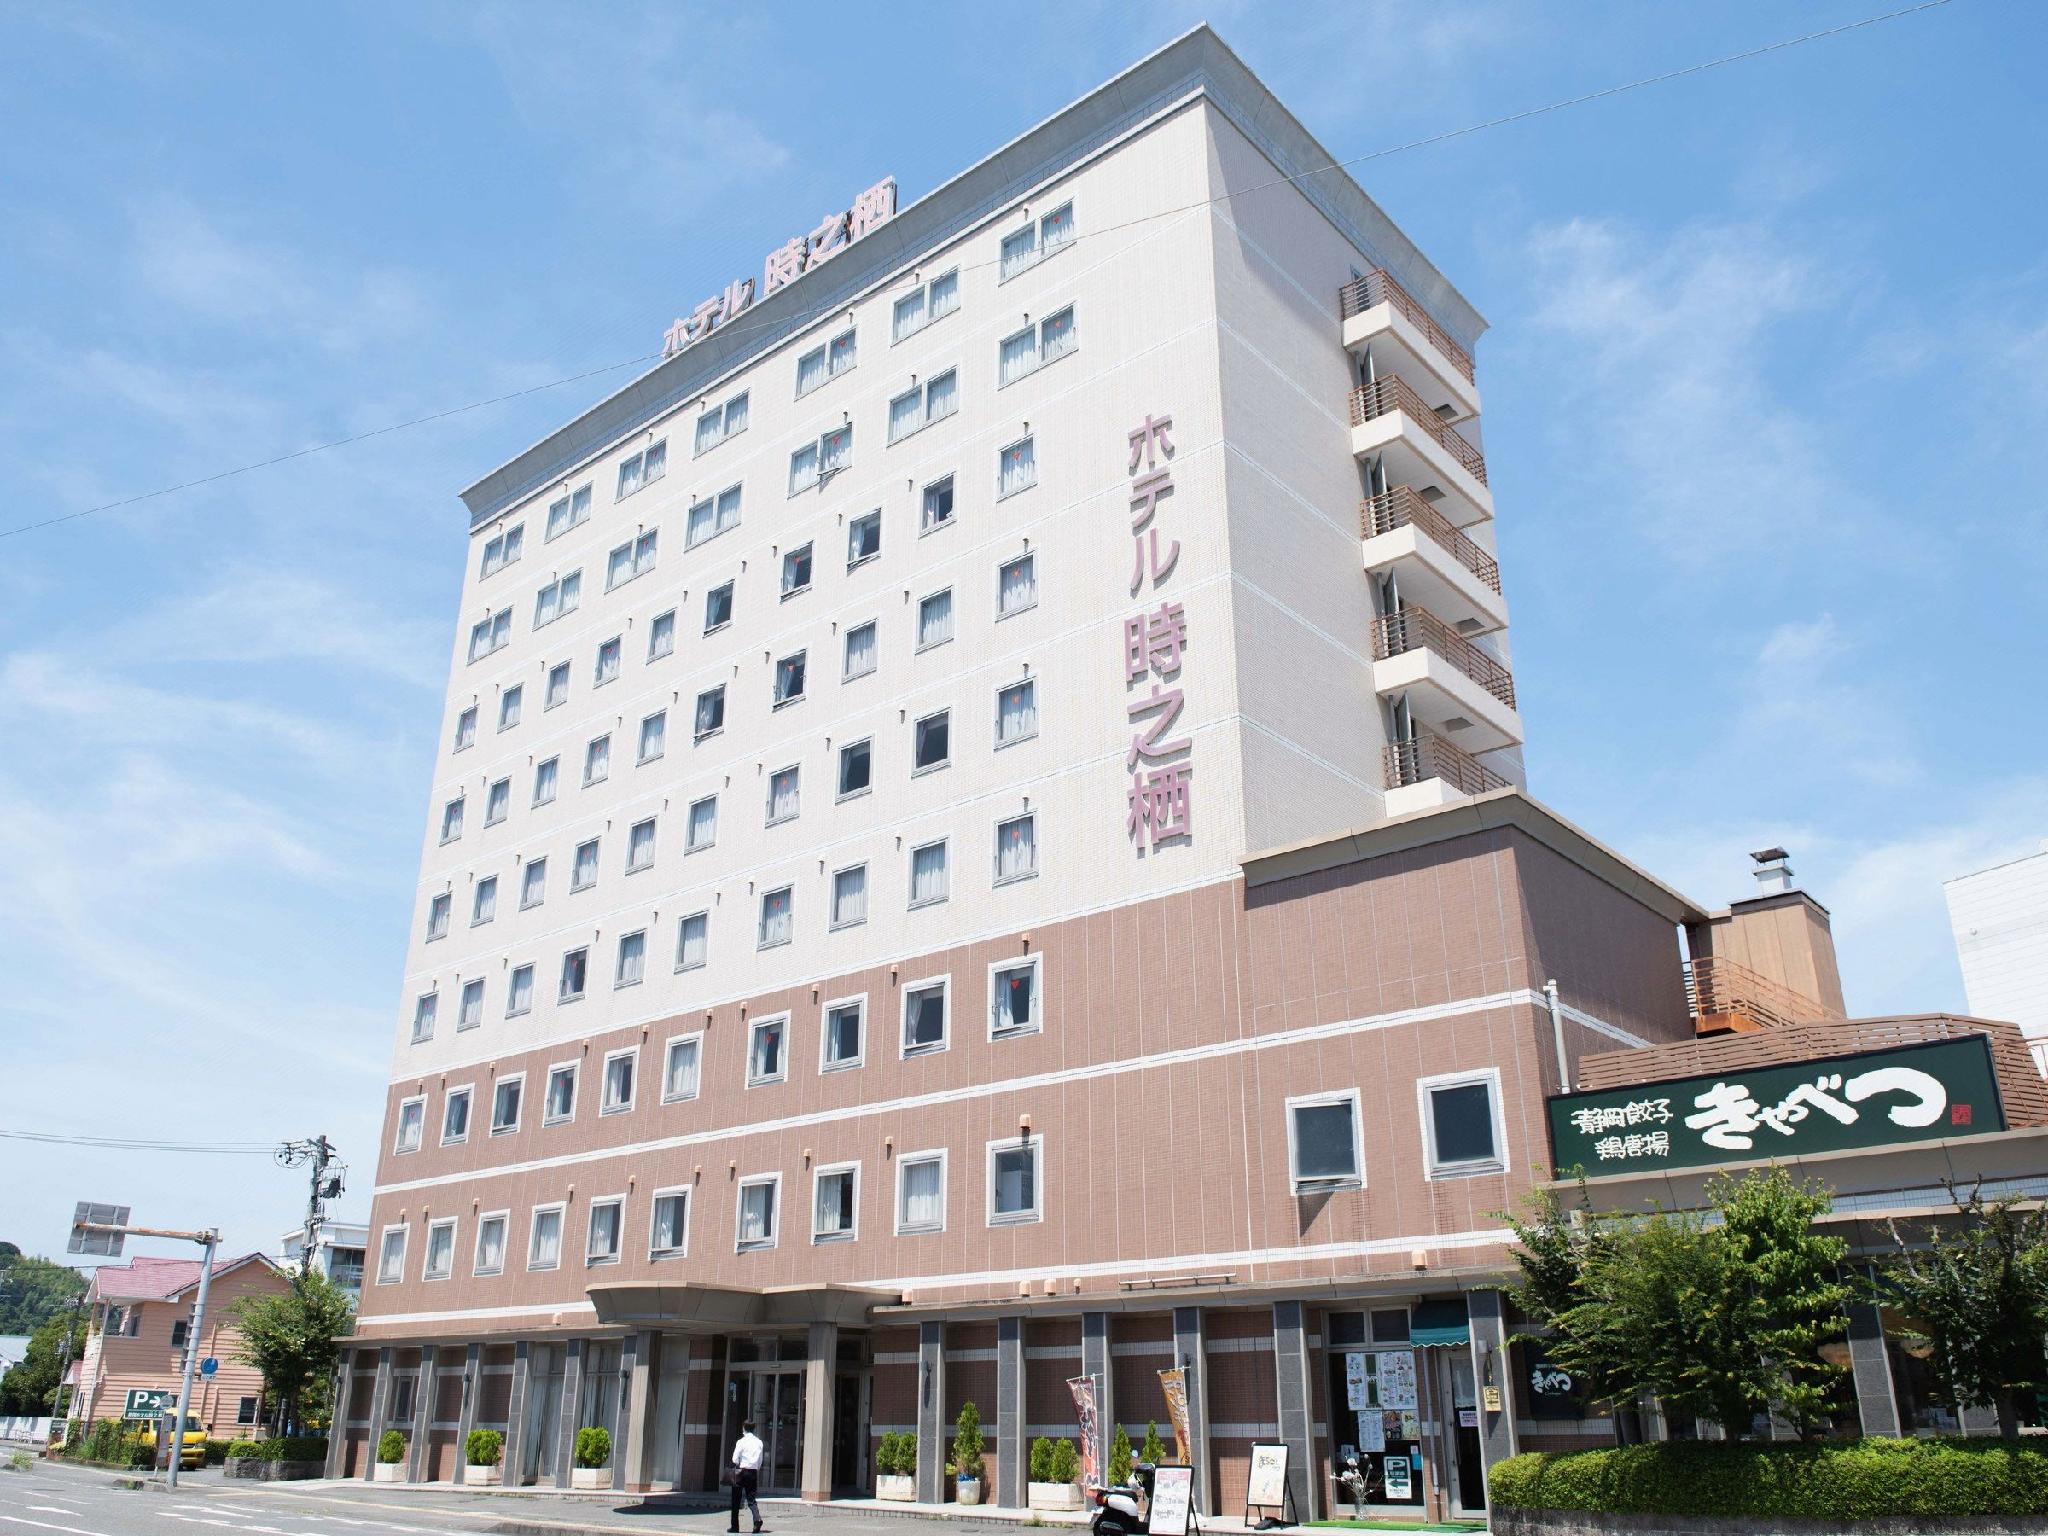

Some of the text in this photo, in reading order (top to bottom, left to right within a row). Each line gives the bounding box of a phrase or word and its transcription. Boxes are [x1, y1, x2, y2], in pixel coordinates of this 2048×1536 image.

[1571, 1098, 1674, 1134] 静岡餃子
[1685, 1067, 1947, 1151] きゃべつ
[133, 1391, 149, 1408] P
[1388, 1460, 1405, 1470] P
